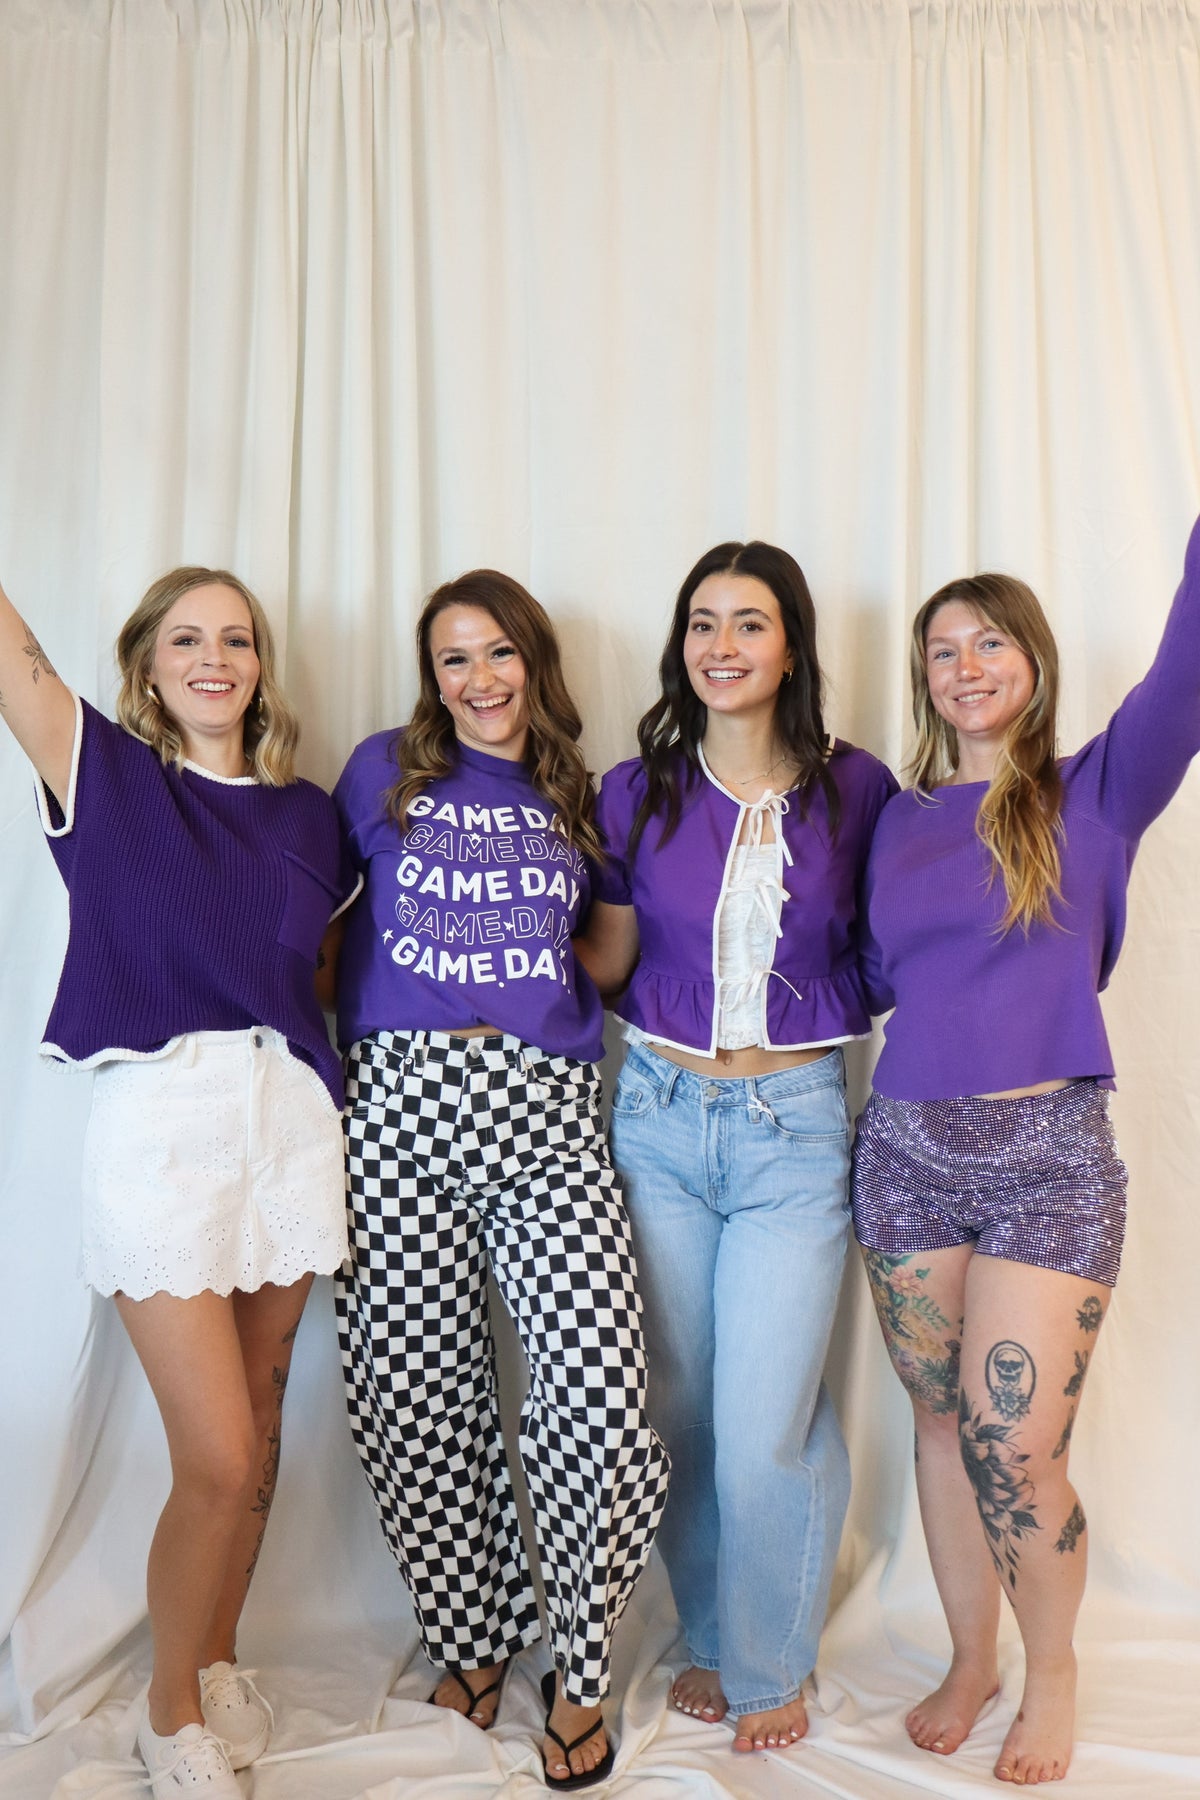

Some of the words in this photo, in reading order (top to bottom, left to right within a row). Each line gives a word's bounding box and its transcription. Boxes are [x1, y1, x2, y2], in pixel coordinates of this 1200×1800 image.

[406, 795, 521, 833] GAME
[403, 823, 520, 863] GAME
[396, 855, 513, 903] GAME
[520, 866, 580, 912] DAY
[394, 895, 506, 945] GAME
[391, 935, 497, 984] GAME
[504, 948, 567, 986] DA
